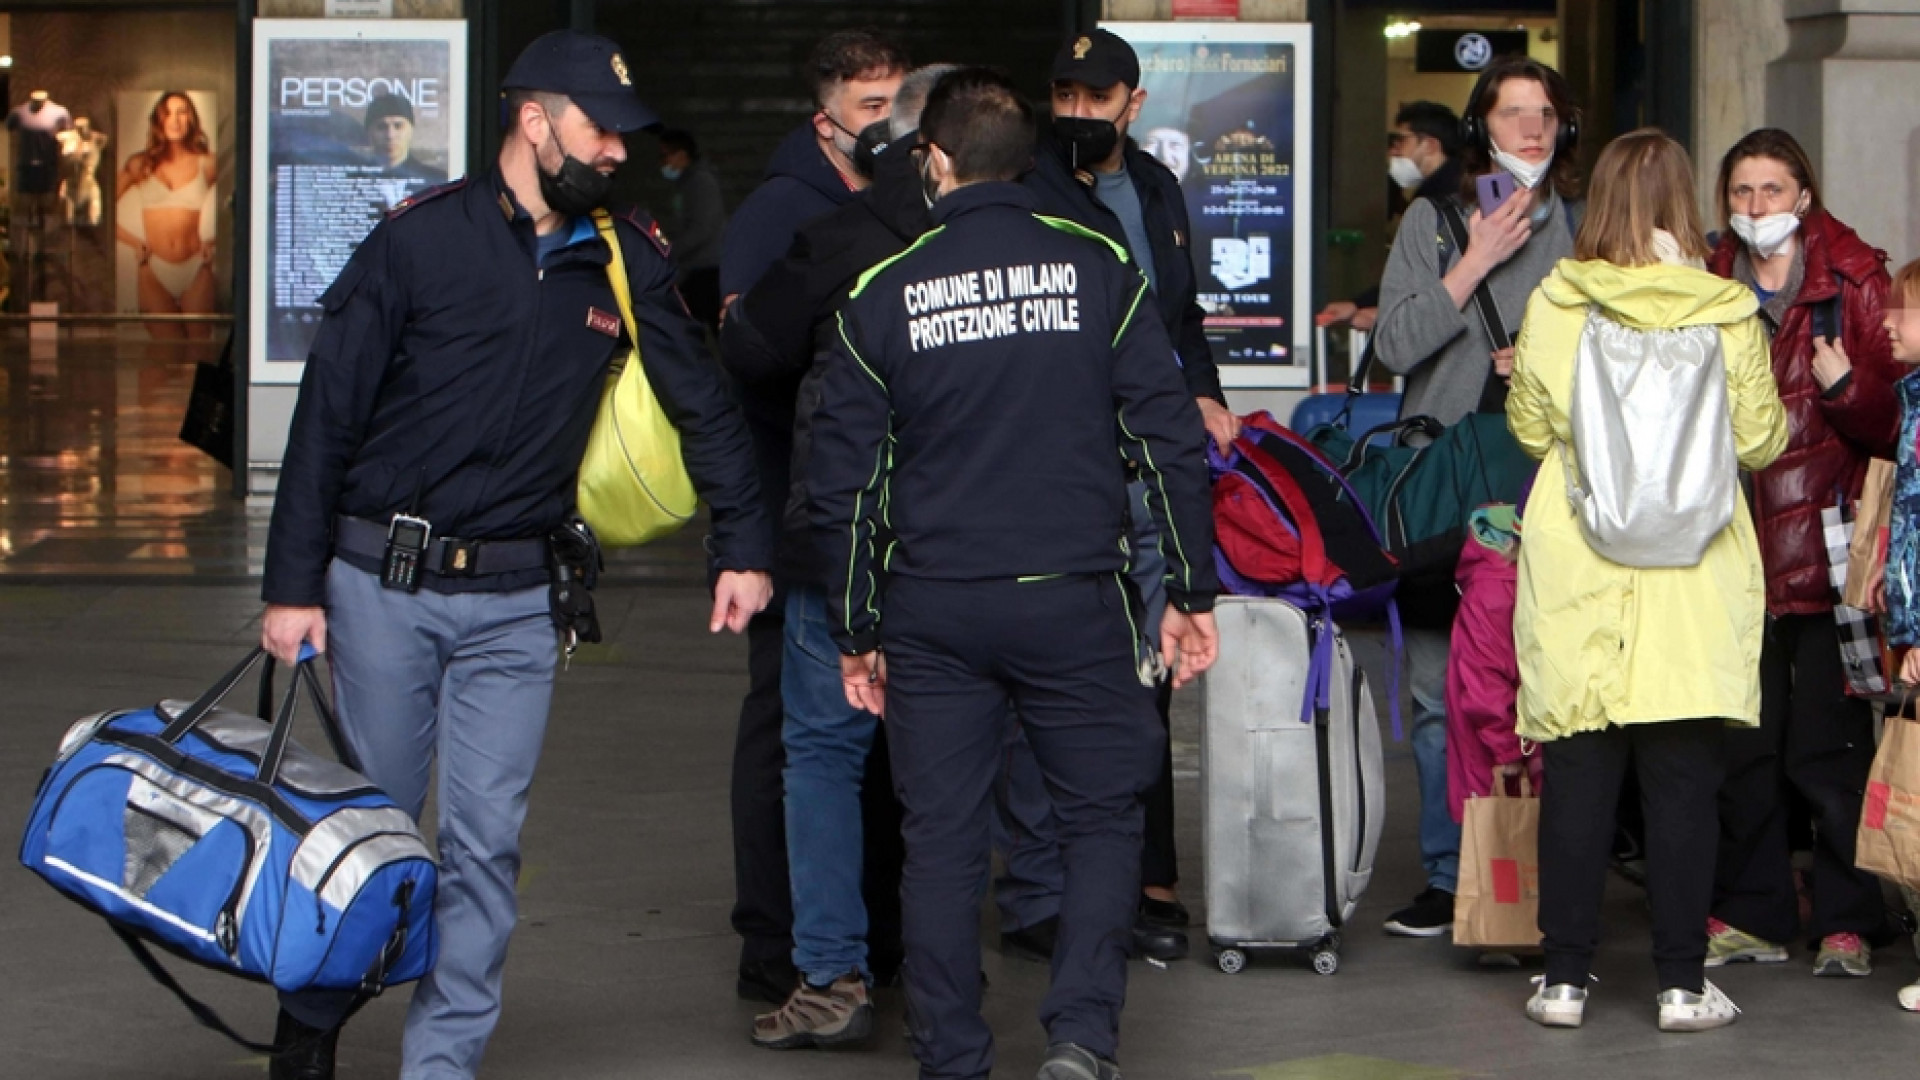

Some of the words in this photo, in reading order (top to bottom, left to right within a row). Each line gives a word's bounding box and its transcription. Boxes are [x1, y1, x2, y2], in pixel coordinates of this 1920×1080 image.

[280, 77, 440, 108] PERSONE
[1203, 164, 1257, 175] VERONA
[1260, 164, 1290, 175] 2022
[1214, 153, 1257, 163] ARENA
[1260, 153, 1276, 163] DI
[904, 271, 981, 316] COMUNE
[984, 267, 1004, 301] DI
[1007, 263, 1078, 298] MILANO
[908, 301, 1018, 352] PROTEZIONE
[1021, 298, 1080, 332] CIVILE
